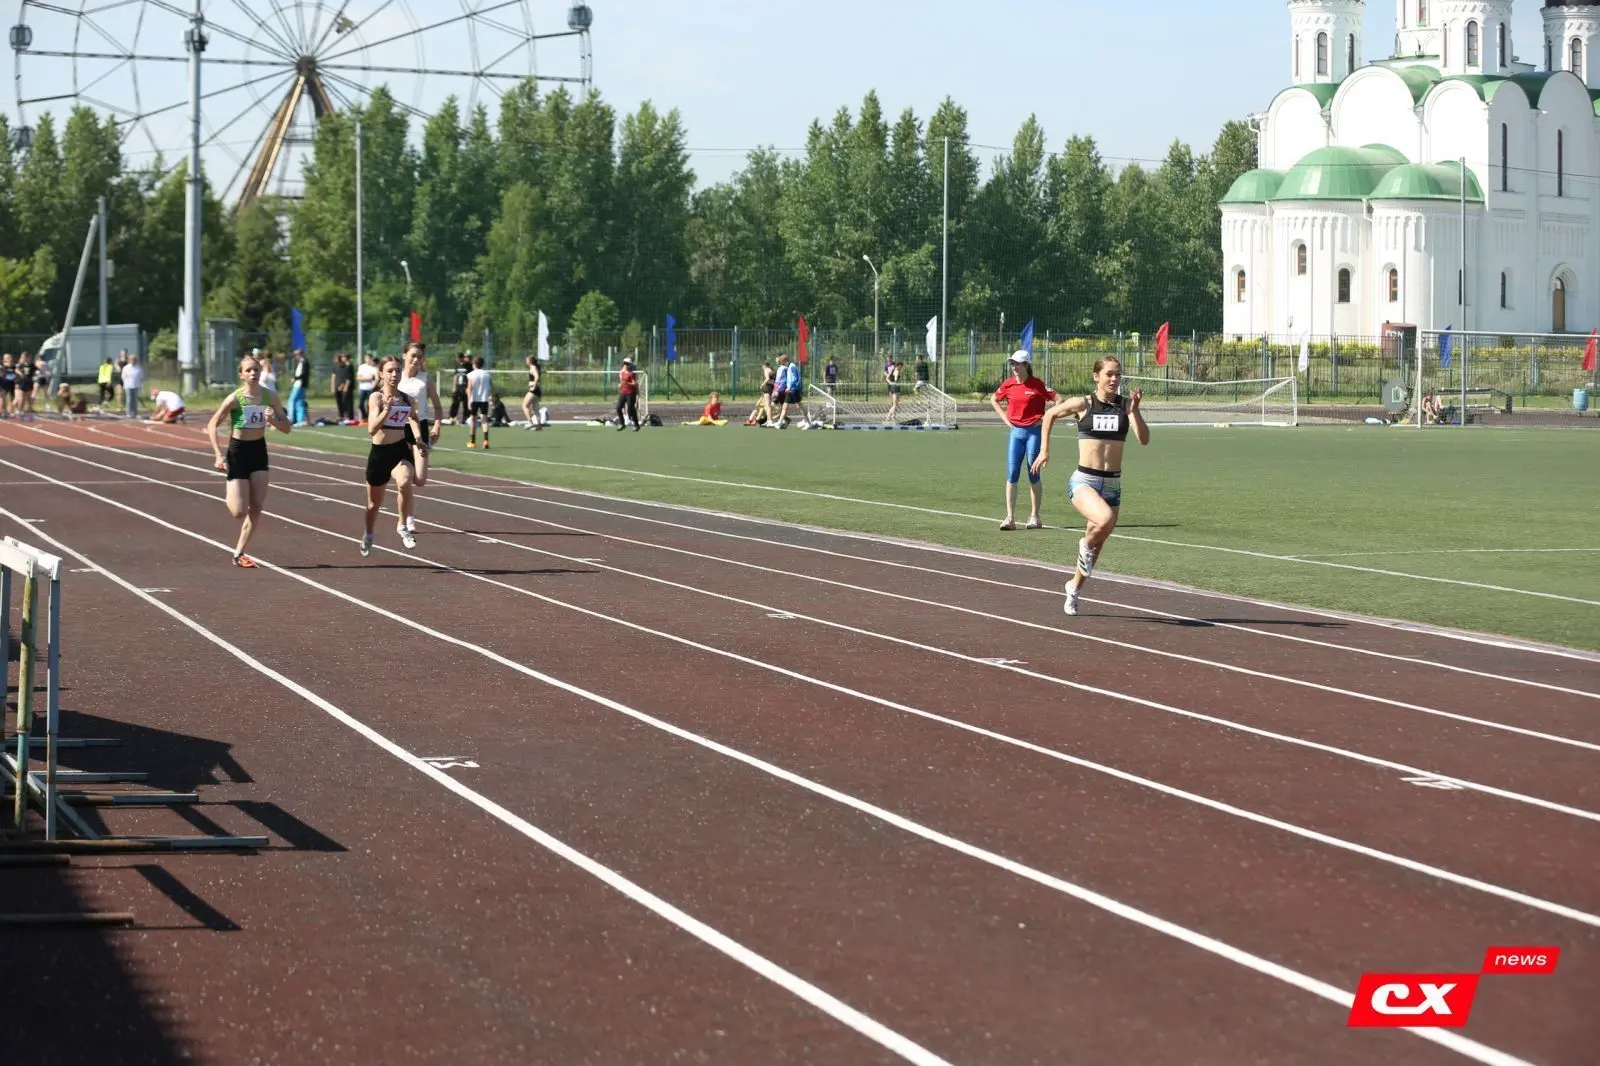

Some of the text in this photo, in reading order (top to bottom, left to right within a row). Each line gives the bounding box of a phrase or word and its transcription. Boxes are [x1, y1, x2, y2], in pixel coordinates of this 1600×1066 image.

[251, 411, 263, 424] 61
[389, 410, 409, 423] 47
[1096, 416, 1116, 429] 777
